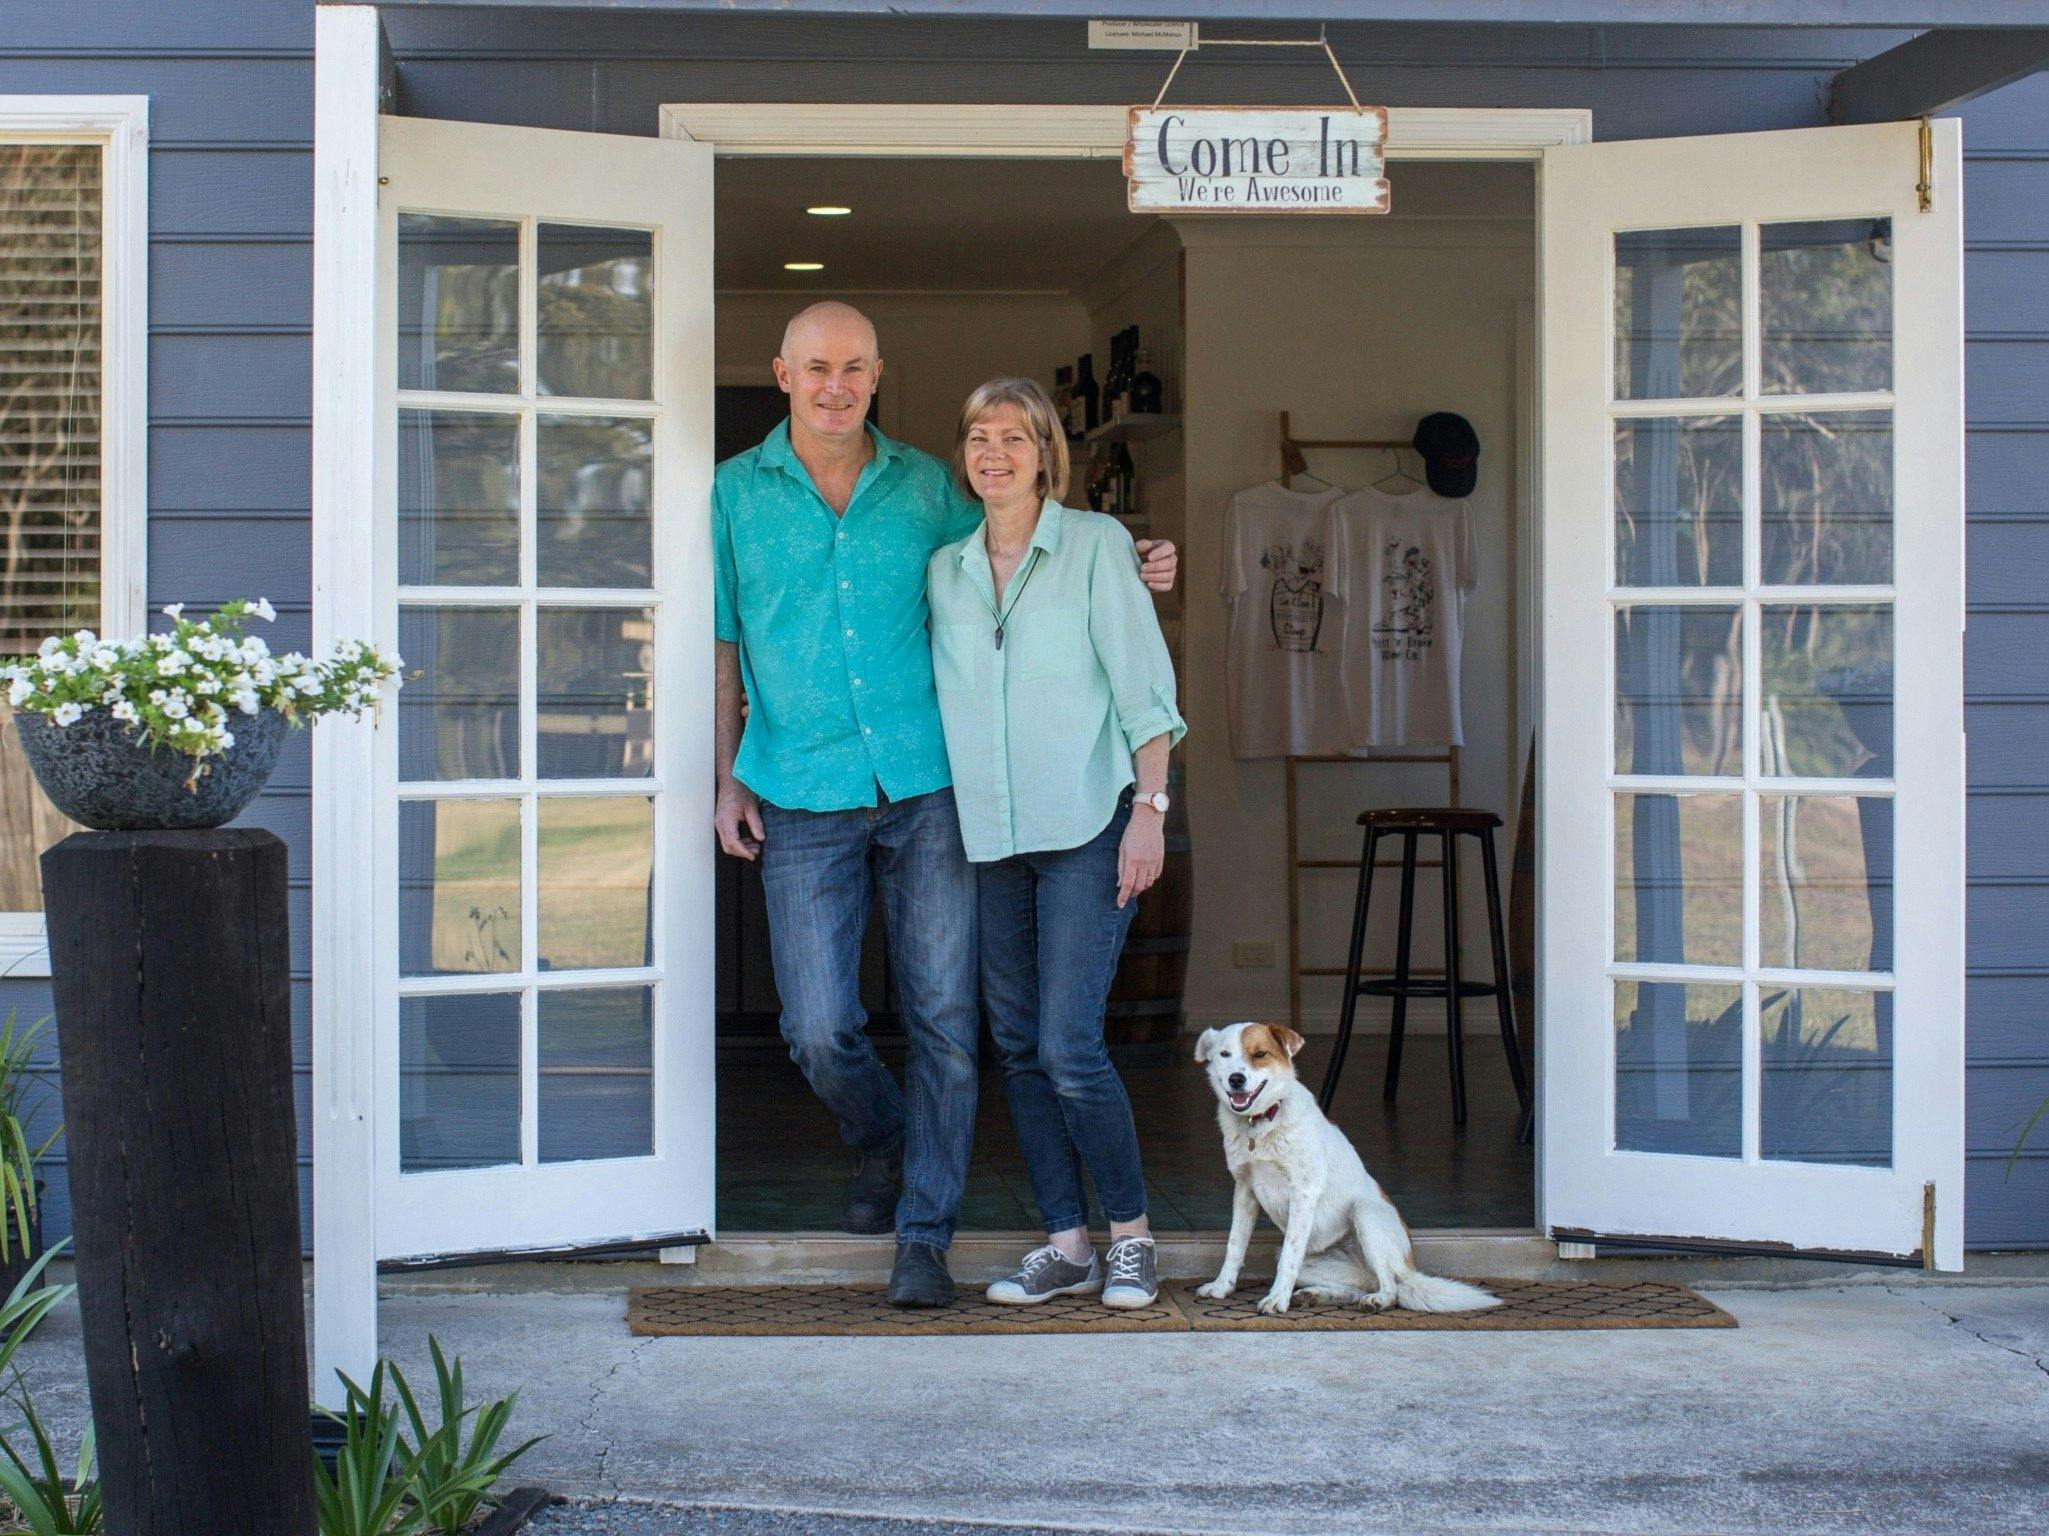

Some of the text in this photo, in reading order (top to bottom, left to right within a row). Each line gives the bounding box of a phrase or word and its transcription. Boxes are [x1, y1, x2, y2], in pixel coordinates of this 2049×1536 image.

[1157, 115, 1362, 178] Come In
[1178, 177, 1343, 203] We're Awesome
